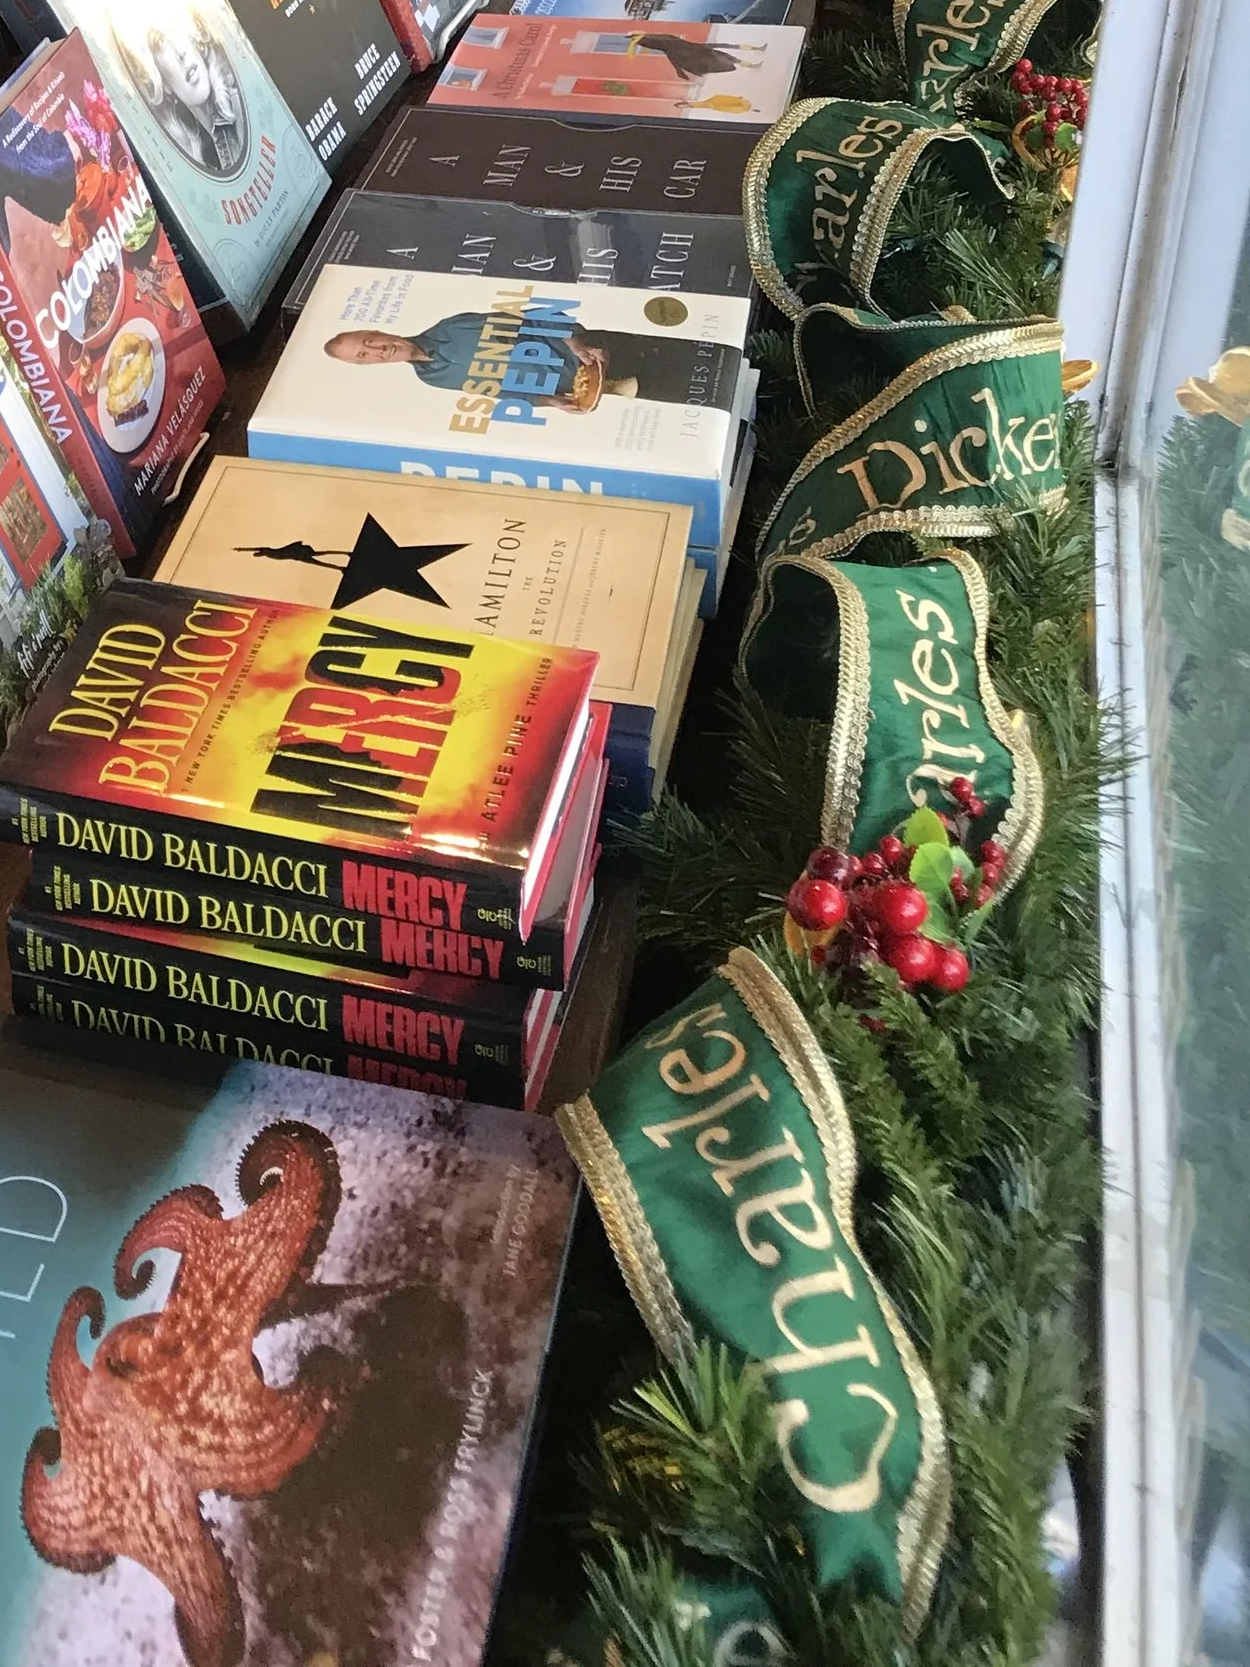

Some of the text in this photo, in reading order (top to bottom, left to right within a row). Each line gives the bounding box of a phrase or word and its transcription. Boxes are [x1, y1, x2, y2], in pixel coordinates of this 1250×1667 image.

[353, 50, 401, 116] SPRINGSTEEN
[354, 42, 381, 80] BRUCE
[496, 46, 532, 94] Christmas
[518, 22, 545, 49] Carol
[305, 96, 338, 142] BARACK
[318, 120, 347, 162] OBAMA
[429, 154, 461, 168] A
[482, 143, 532, 187] MAN
[544, 161, 586, 178] &
[599, 155, 644, 193] HIS
[663, 159, 708, 199] CAR
[221, 134, 277, 226] SONGTELLER
[35, 174, 152, 349] COLOMBIANA
[386, 245, 622, 287] A & HIS
[448, 285, 535, 435] ESSENTIAL
[490, 297, 582, 427] PEPIN
[693, 312, 721, 359] PÉPIN
[134, 433, 170, 497] MARIANA
[166, 365, 207, 437] VELÁSQUEZ
[680, 363, 711, 440] JACQUES
[522, 576, 534, 591] THE
[529, 538, 567, 636] REVOLUTION
[49, 623, 167, 742] DAVID
[98, 599, 258, 798] BALDACCI
[186, 608, 280, 784] NEW YORK TIMES BESTSELLING AUTHOR
[250, 615, 476, 842] MERCY
[480, 657, 554, 823] ATLEE PINE THRILLER
[57, 812, 467, 933] DAVID BALDACCI MERCY
[90, 878, 504, 981] DAVID BALDACCI MERCY
[61, 942, 466, 1066] DAVID BALDACCI MERCY
[71, 999, 167, 1044] DAVID
[503, 1168, 539, 1278] JANE GOODALL
[646, 1000, 900, 1516] Charles
[454, 1368, 495, 1475] FRYLINCK
